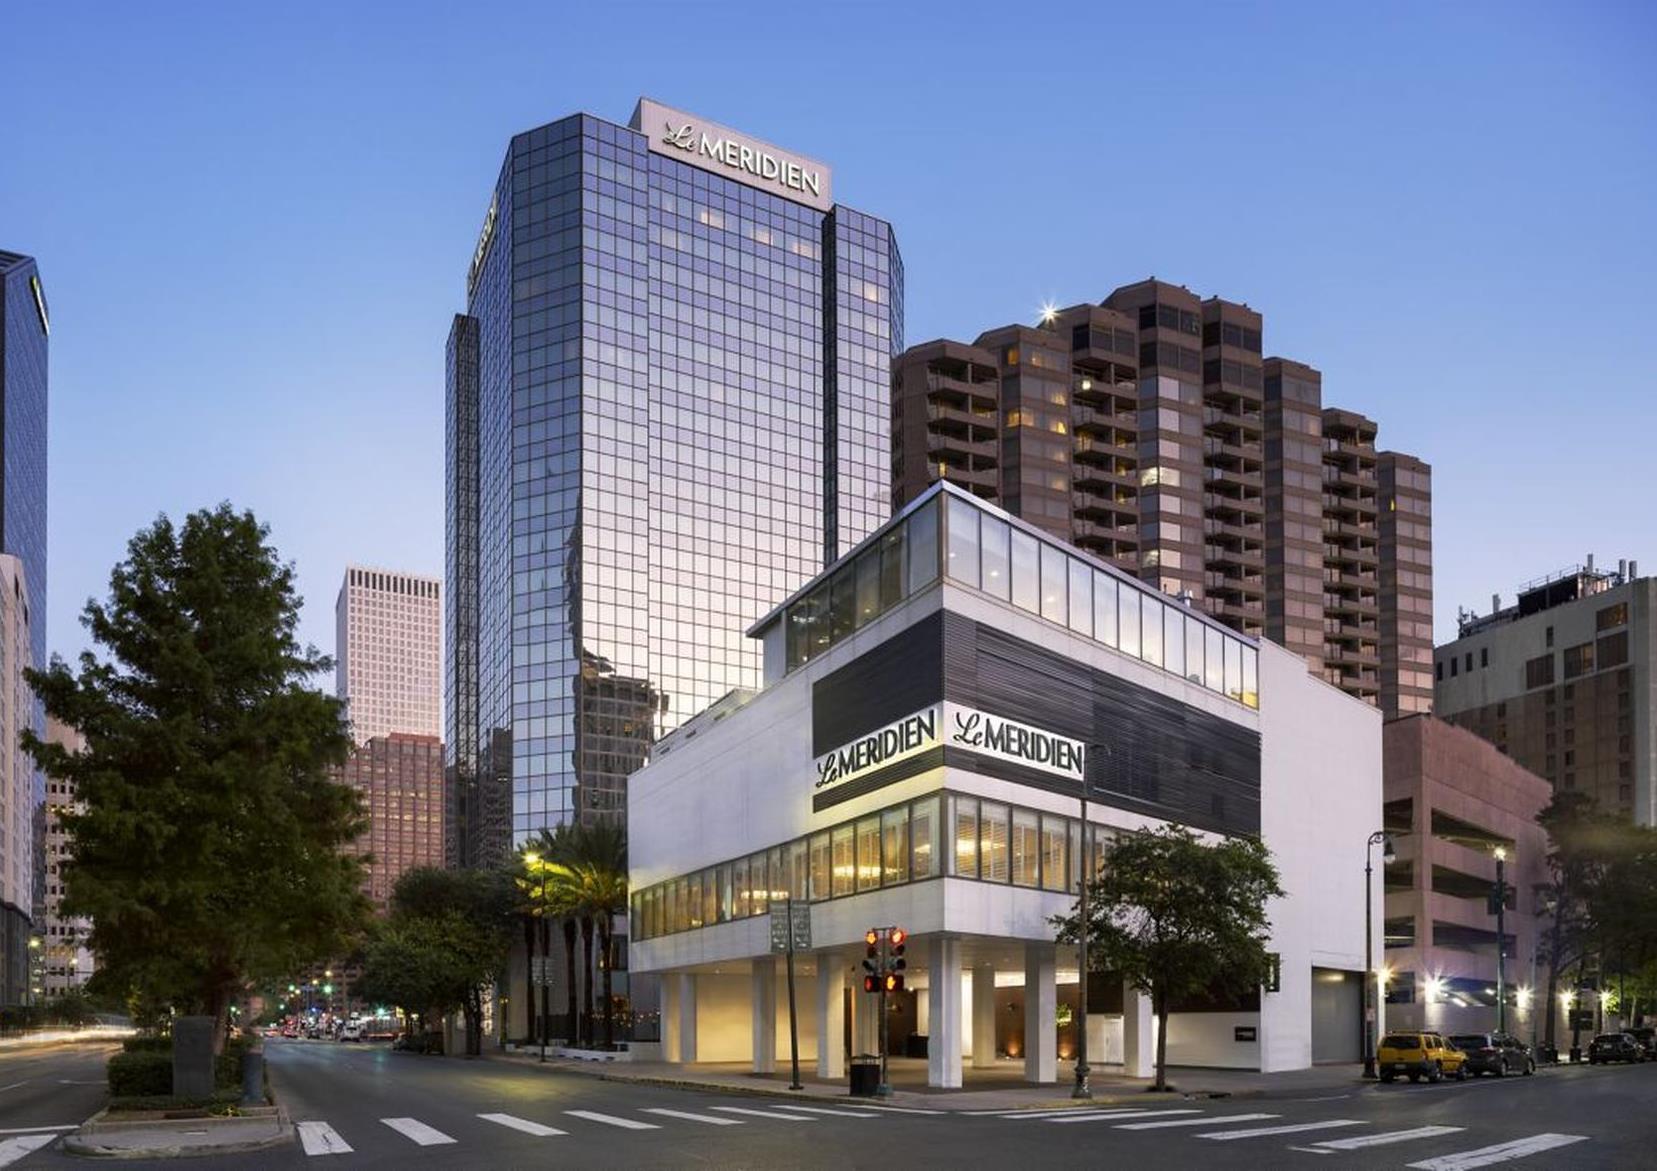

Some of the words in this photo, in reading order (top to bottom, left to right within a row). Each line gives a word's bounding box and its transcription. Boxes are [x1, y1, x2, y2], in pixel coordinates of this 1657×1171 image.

[662, 121, 697, 152] Le
[699, 133, 819, 196] MERIDIEN
[815, 753, 838, 788] Le
[837, 710, 935, 776] MERIDIEN
[952, 711, 984, 747] Le
[984, 718, 1083, 774] MERIDIEN
